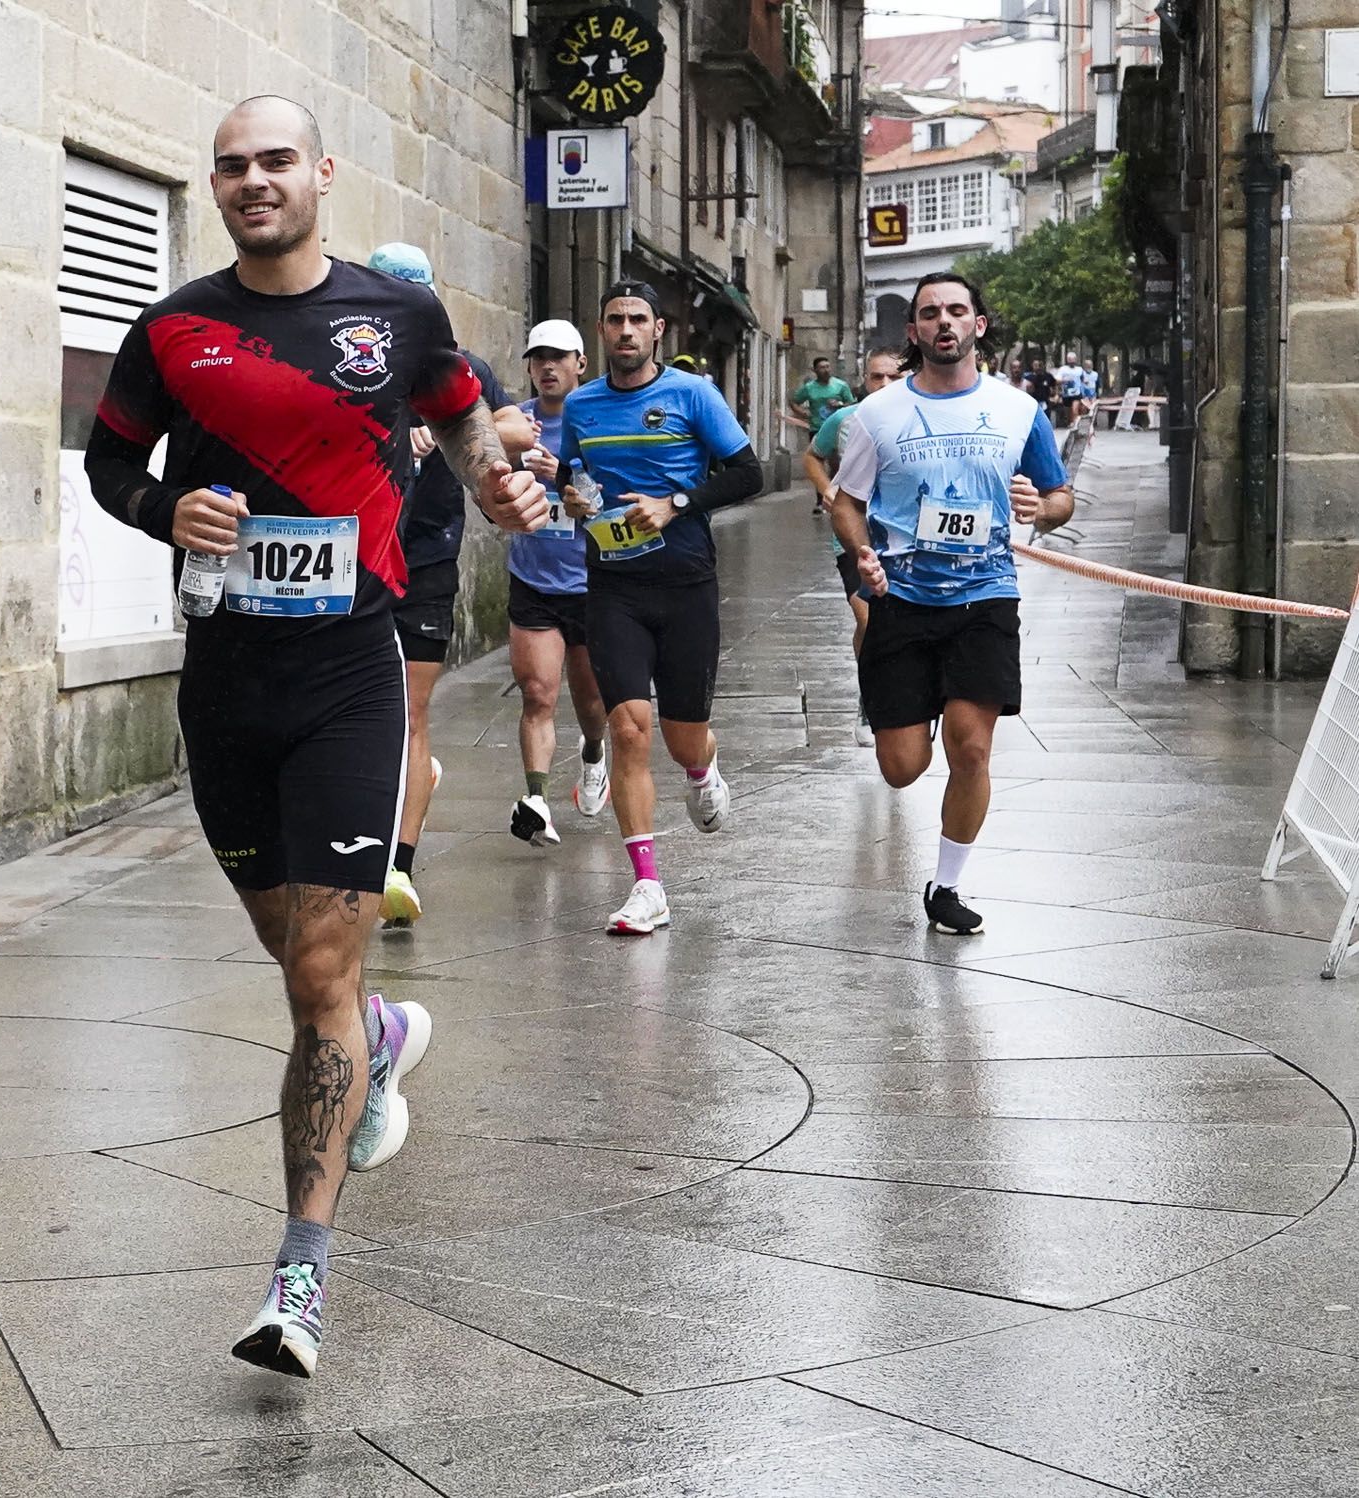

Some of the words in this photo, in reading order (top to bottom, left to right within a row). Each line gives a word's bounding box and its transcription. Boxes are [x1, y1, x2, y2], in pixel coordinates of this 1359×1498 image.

[557, 16, 602, 65] CAFE
[610, 16, 650, 57] BAR
[568, 73, 643, 112] PARIS
[597, 185, 609, 193] del
[558, 195, 585, 203] Estado
[393, 268, 425, 280] HOKA
[329, 315, 372, 328] Asociación
[374, 317, 382, 325] C.
[383, 322, 391, 330] D.
[191, 357, 233, 368] amura
[330, 370, 362, 392] Bombeiros
[363, 372, 393, 392] Pontevedra
[916, 439, 936, 449] GRAN
[938, 438, 964, 447] FONDO
[901, 446, 985, 464] PONTEVEDRA
[992, 447, 1005, 459] 24
[938, 512, 975, 536] 783
[266, 527, 319, 536] PONTEVEDRA
[321, 527, 331, 535] 24
[247, 541, 334, 582] 1024
[275, 586, 304, 596] HÉCTOR
